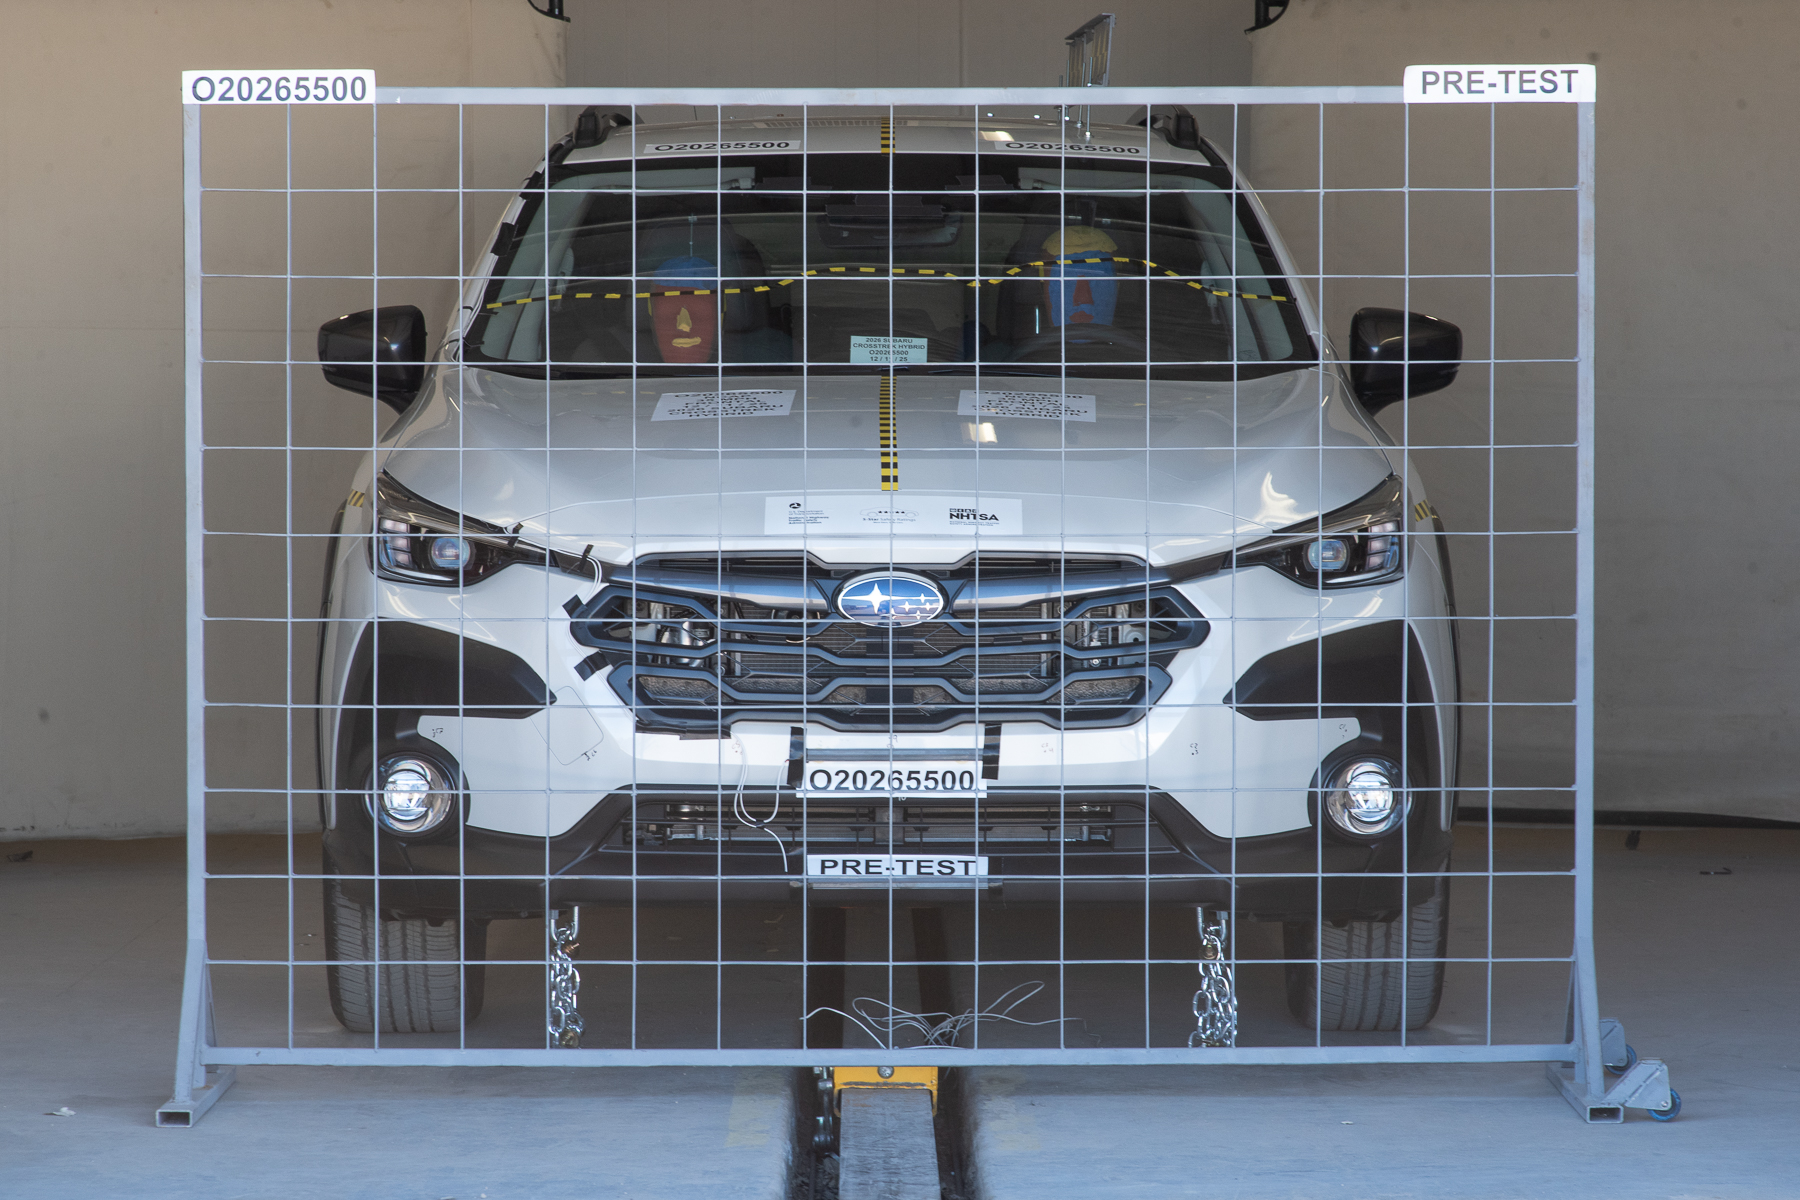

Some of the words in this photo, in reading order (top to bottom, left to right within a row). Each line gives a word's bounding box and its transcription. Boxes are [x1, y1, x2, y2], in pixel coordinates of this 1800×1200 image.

[192, 76, 366, 101] O20265500
[1422, 70, 1578, 94] PRE-TEST
[655, 142, 790, 151] O20265500
[1006, 142, 1140, 154] O20265500
[810, 769, 973, 790] O20265500
[820, 860, 976, 875] PRE-TEST
